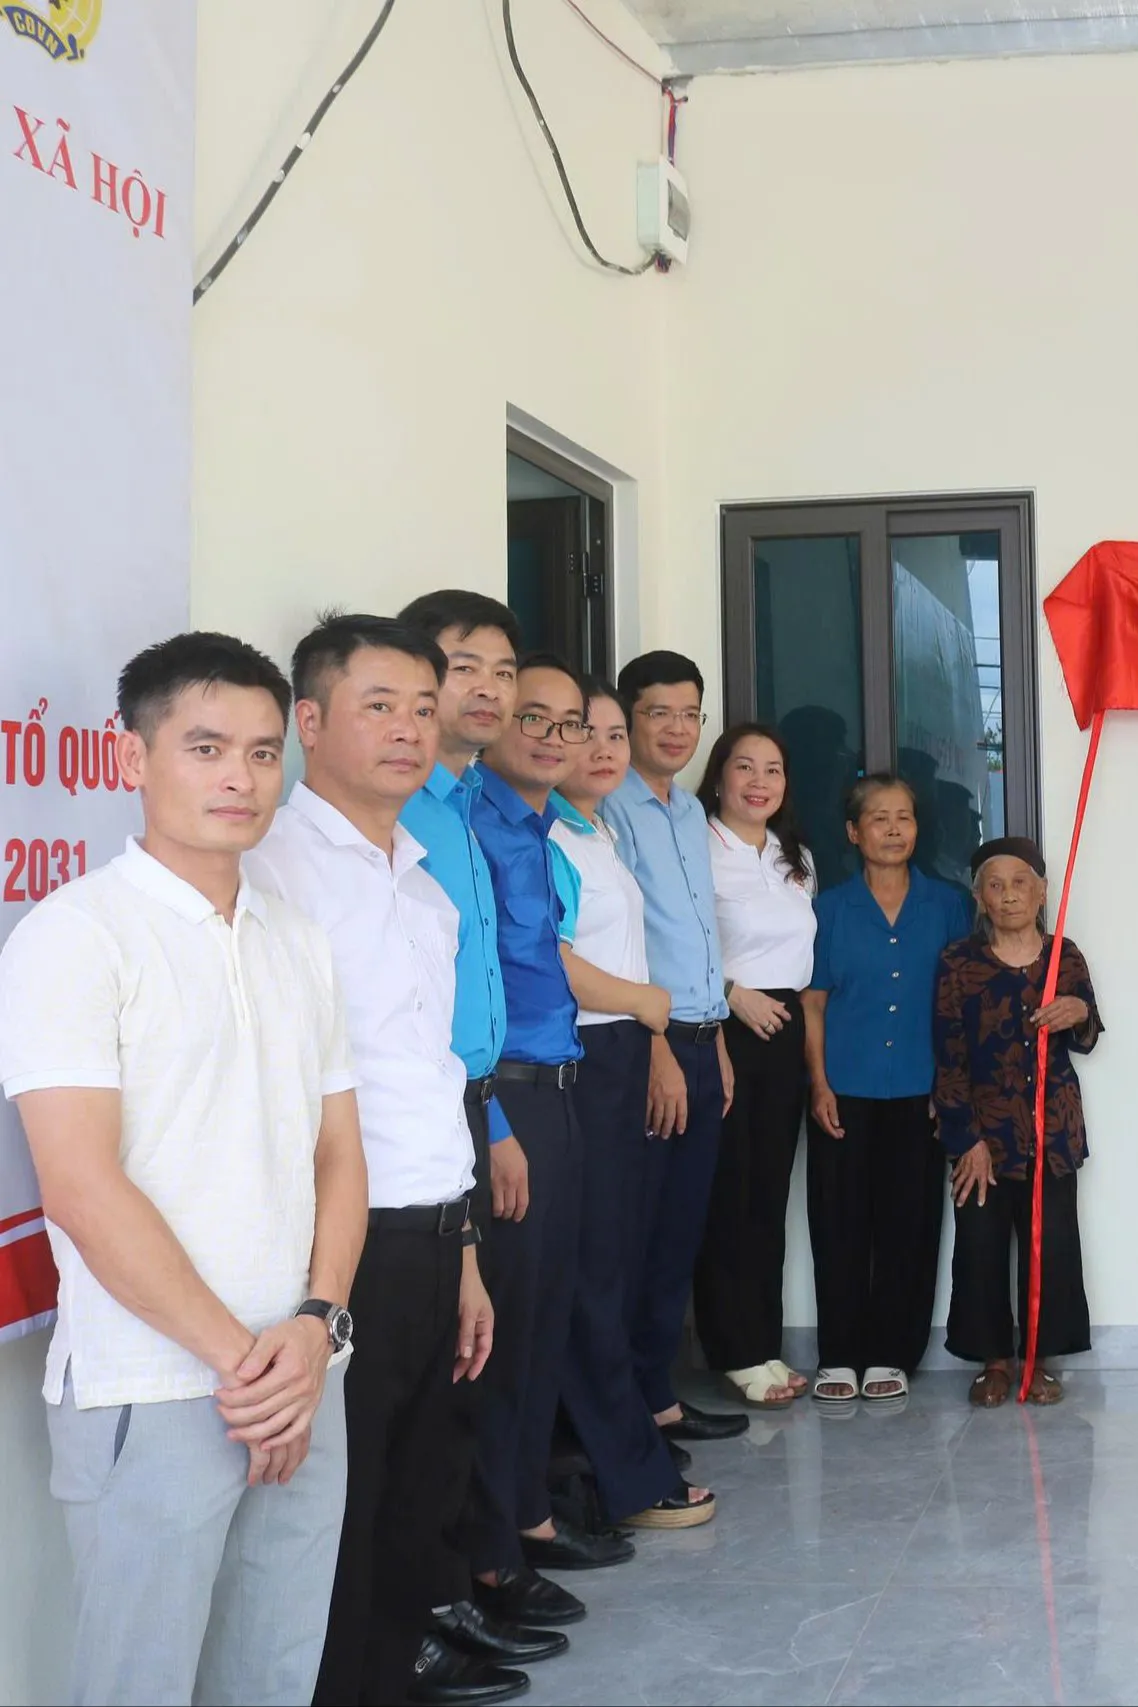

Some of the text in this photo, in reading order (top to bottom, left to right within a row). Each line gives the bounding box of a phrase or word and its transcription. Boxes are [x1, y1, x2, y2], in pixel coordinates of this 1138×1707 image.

[13, 104, 168, 240] XÃ HỘI
[1, 697, 136, 796] TỔ QUỐ
[3, 838, 86, 902] 2031
